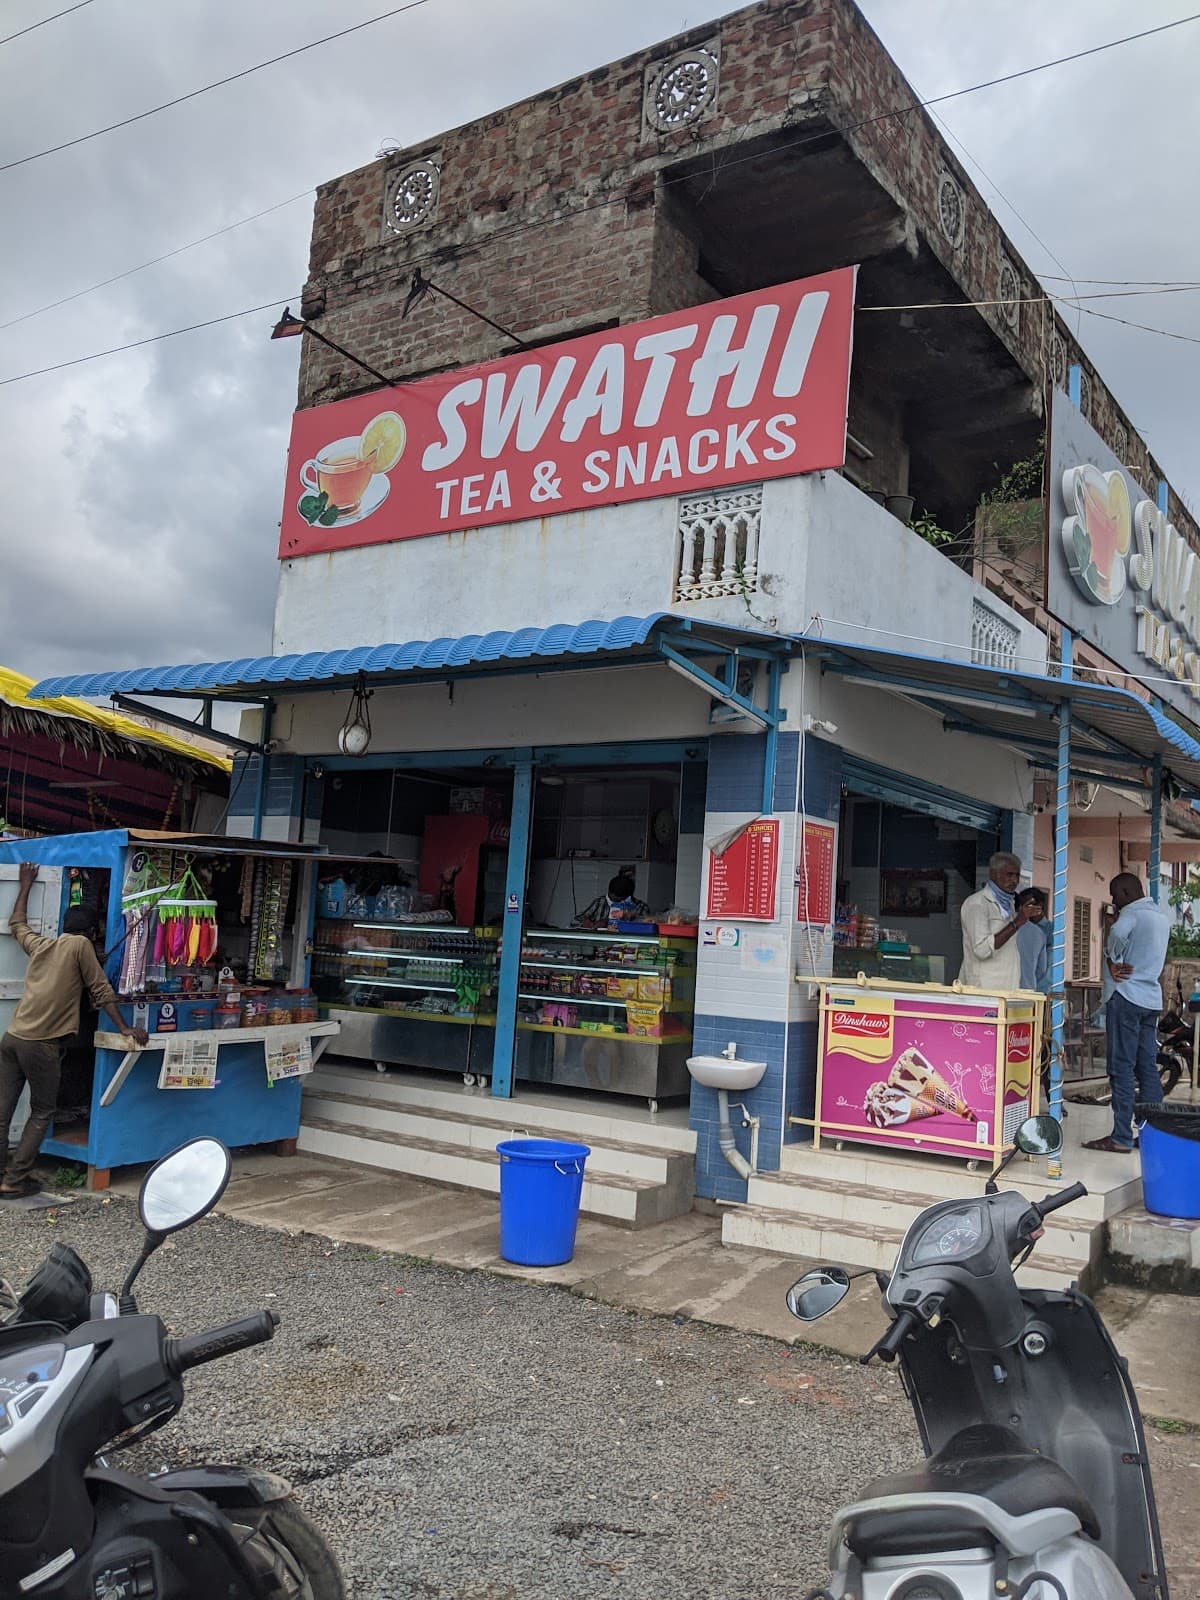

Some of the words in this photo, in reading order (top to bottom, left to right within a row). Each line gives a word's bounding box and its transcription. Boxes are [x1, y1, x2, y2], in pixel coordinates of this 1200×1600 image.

[421, 291, 829, 471] SWATHI
[435, 469, 512, 519] TEA
[530, 461, 562, 502] &
[583, 414, 797, 492] SNACKS
[833, 1012, 889, 1029] Dinshaw's
